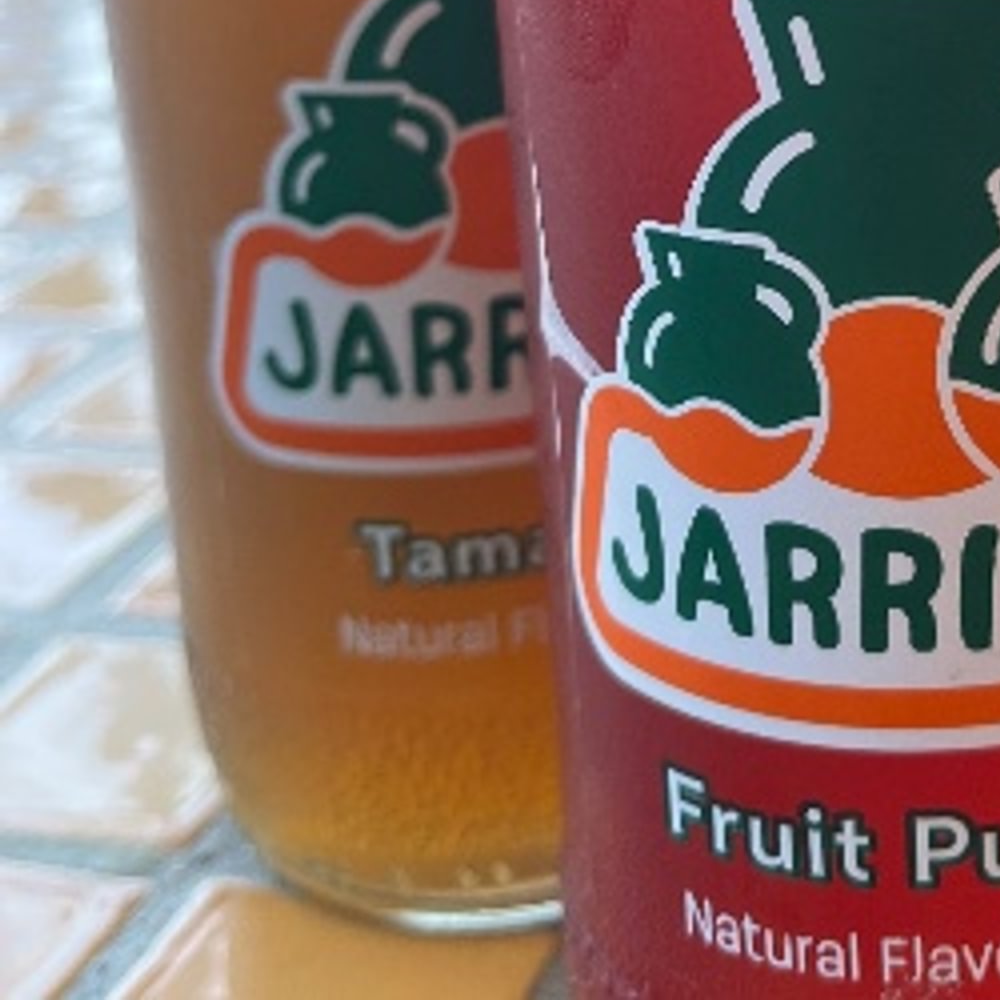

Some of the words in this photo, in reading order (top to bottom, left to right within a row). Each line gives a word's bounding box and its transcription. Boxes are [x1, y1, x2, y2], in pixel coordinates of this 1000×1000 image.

[337, 610, 499, 662] Natural
[663, 762, 878, 886] Fruit
[682, 890, 860, 983] Natural
